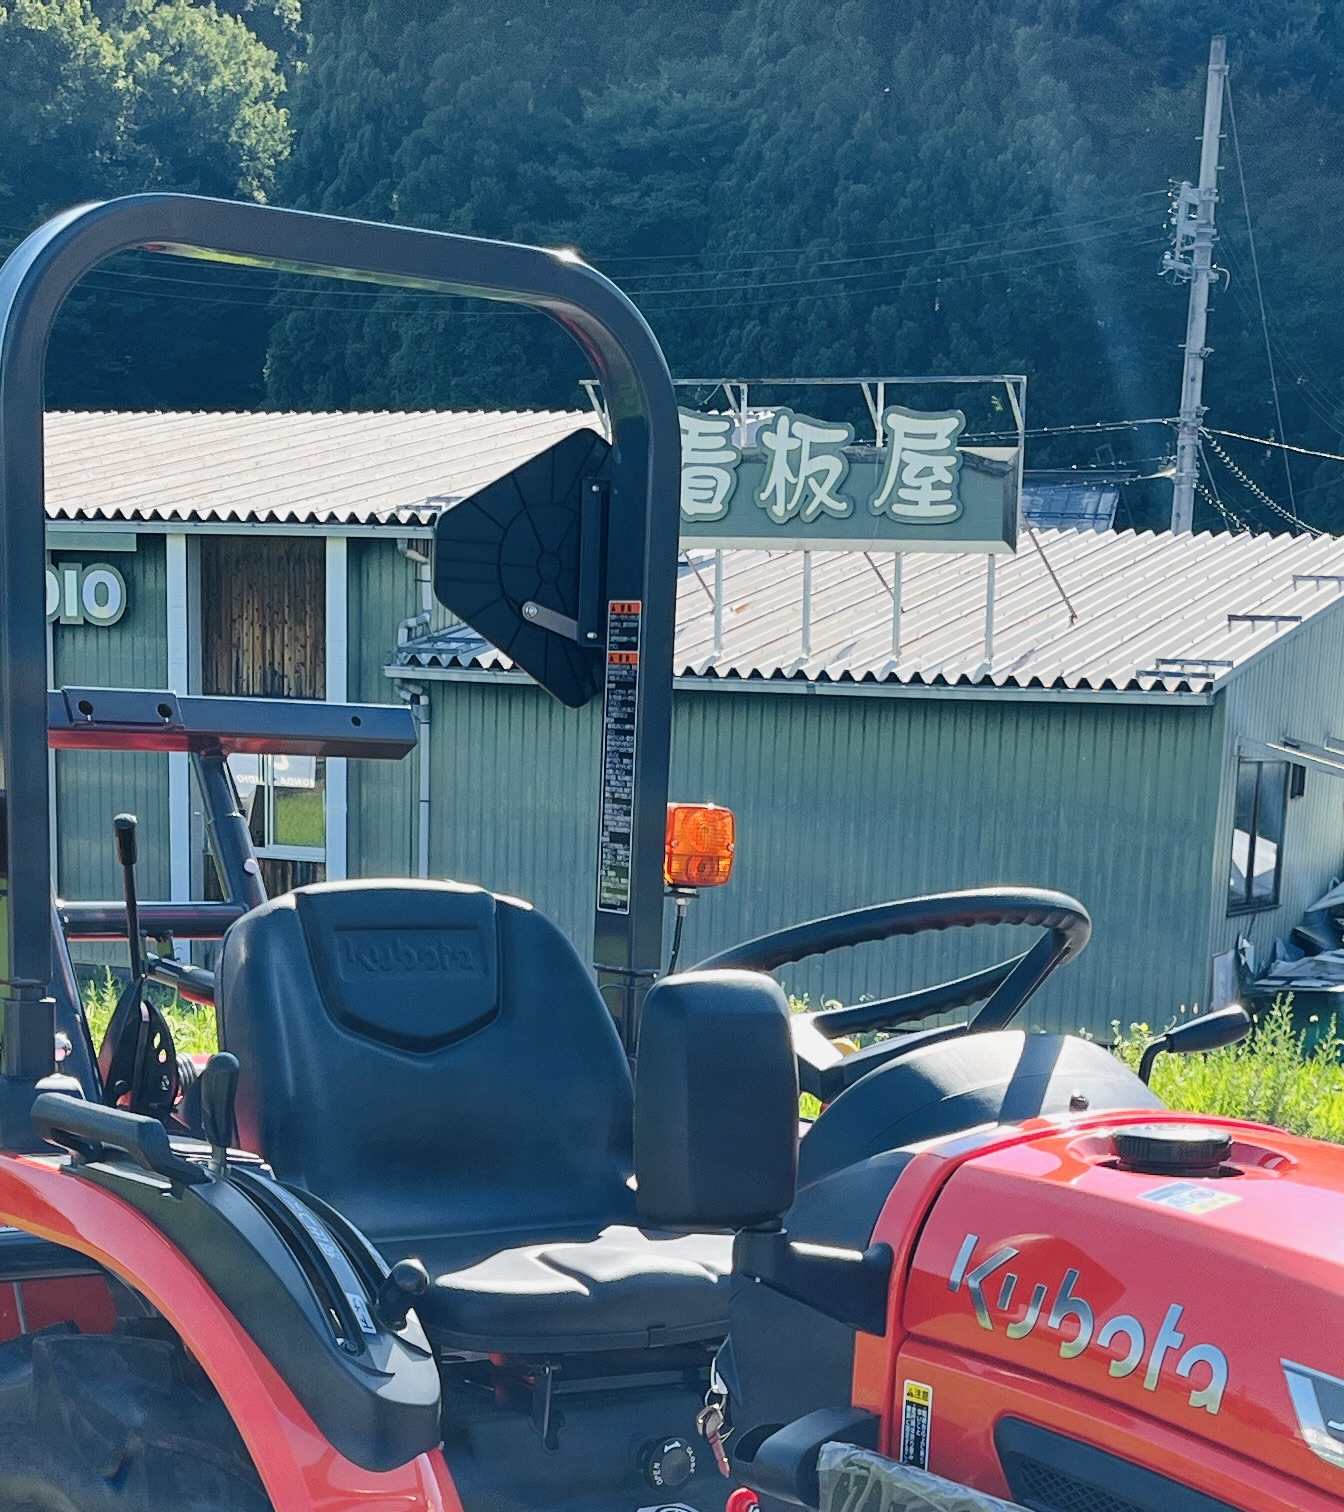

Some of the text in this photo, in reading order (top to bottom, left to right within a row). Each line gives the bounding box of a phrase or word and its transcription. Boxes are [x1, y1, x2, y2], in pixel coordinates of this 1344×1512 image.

[678, 411, 960, 519] 看板屋
[343, 935, 475, 973] Kubota
[946, 1233, 1230, 1415] Kubota
[652, 1462, 664, 1486] OPEN
[685, 1445, 696, 1474] CLOSE
